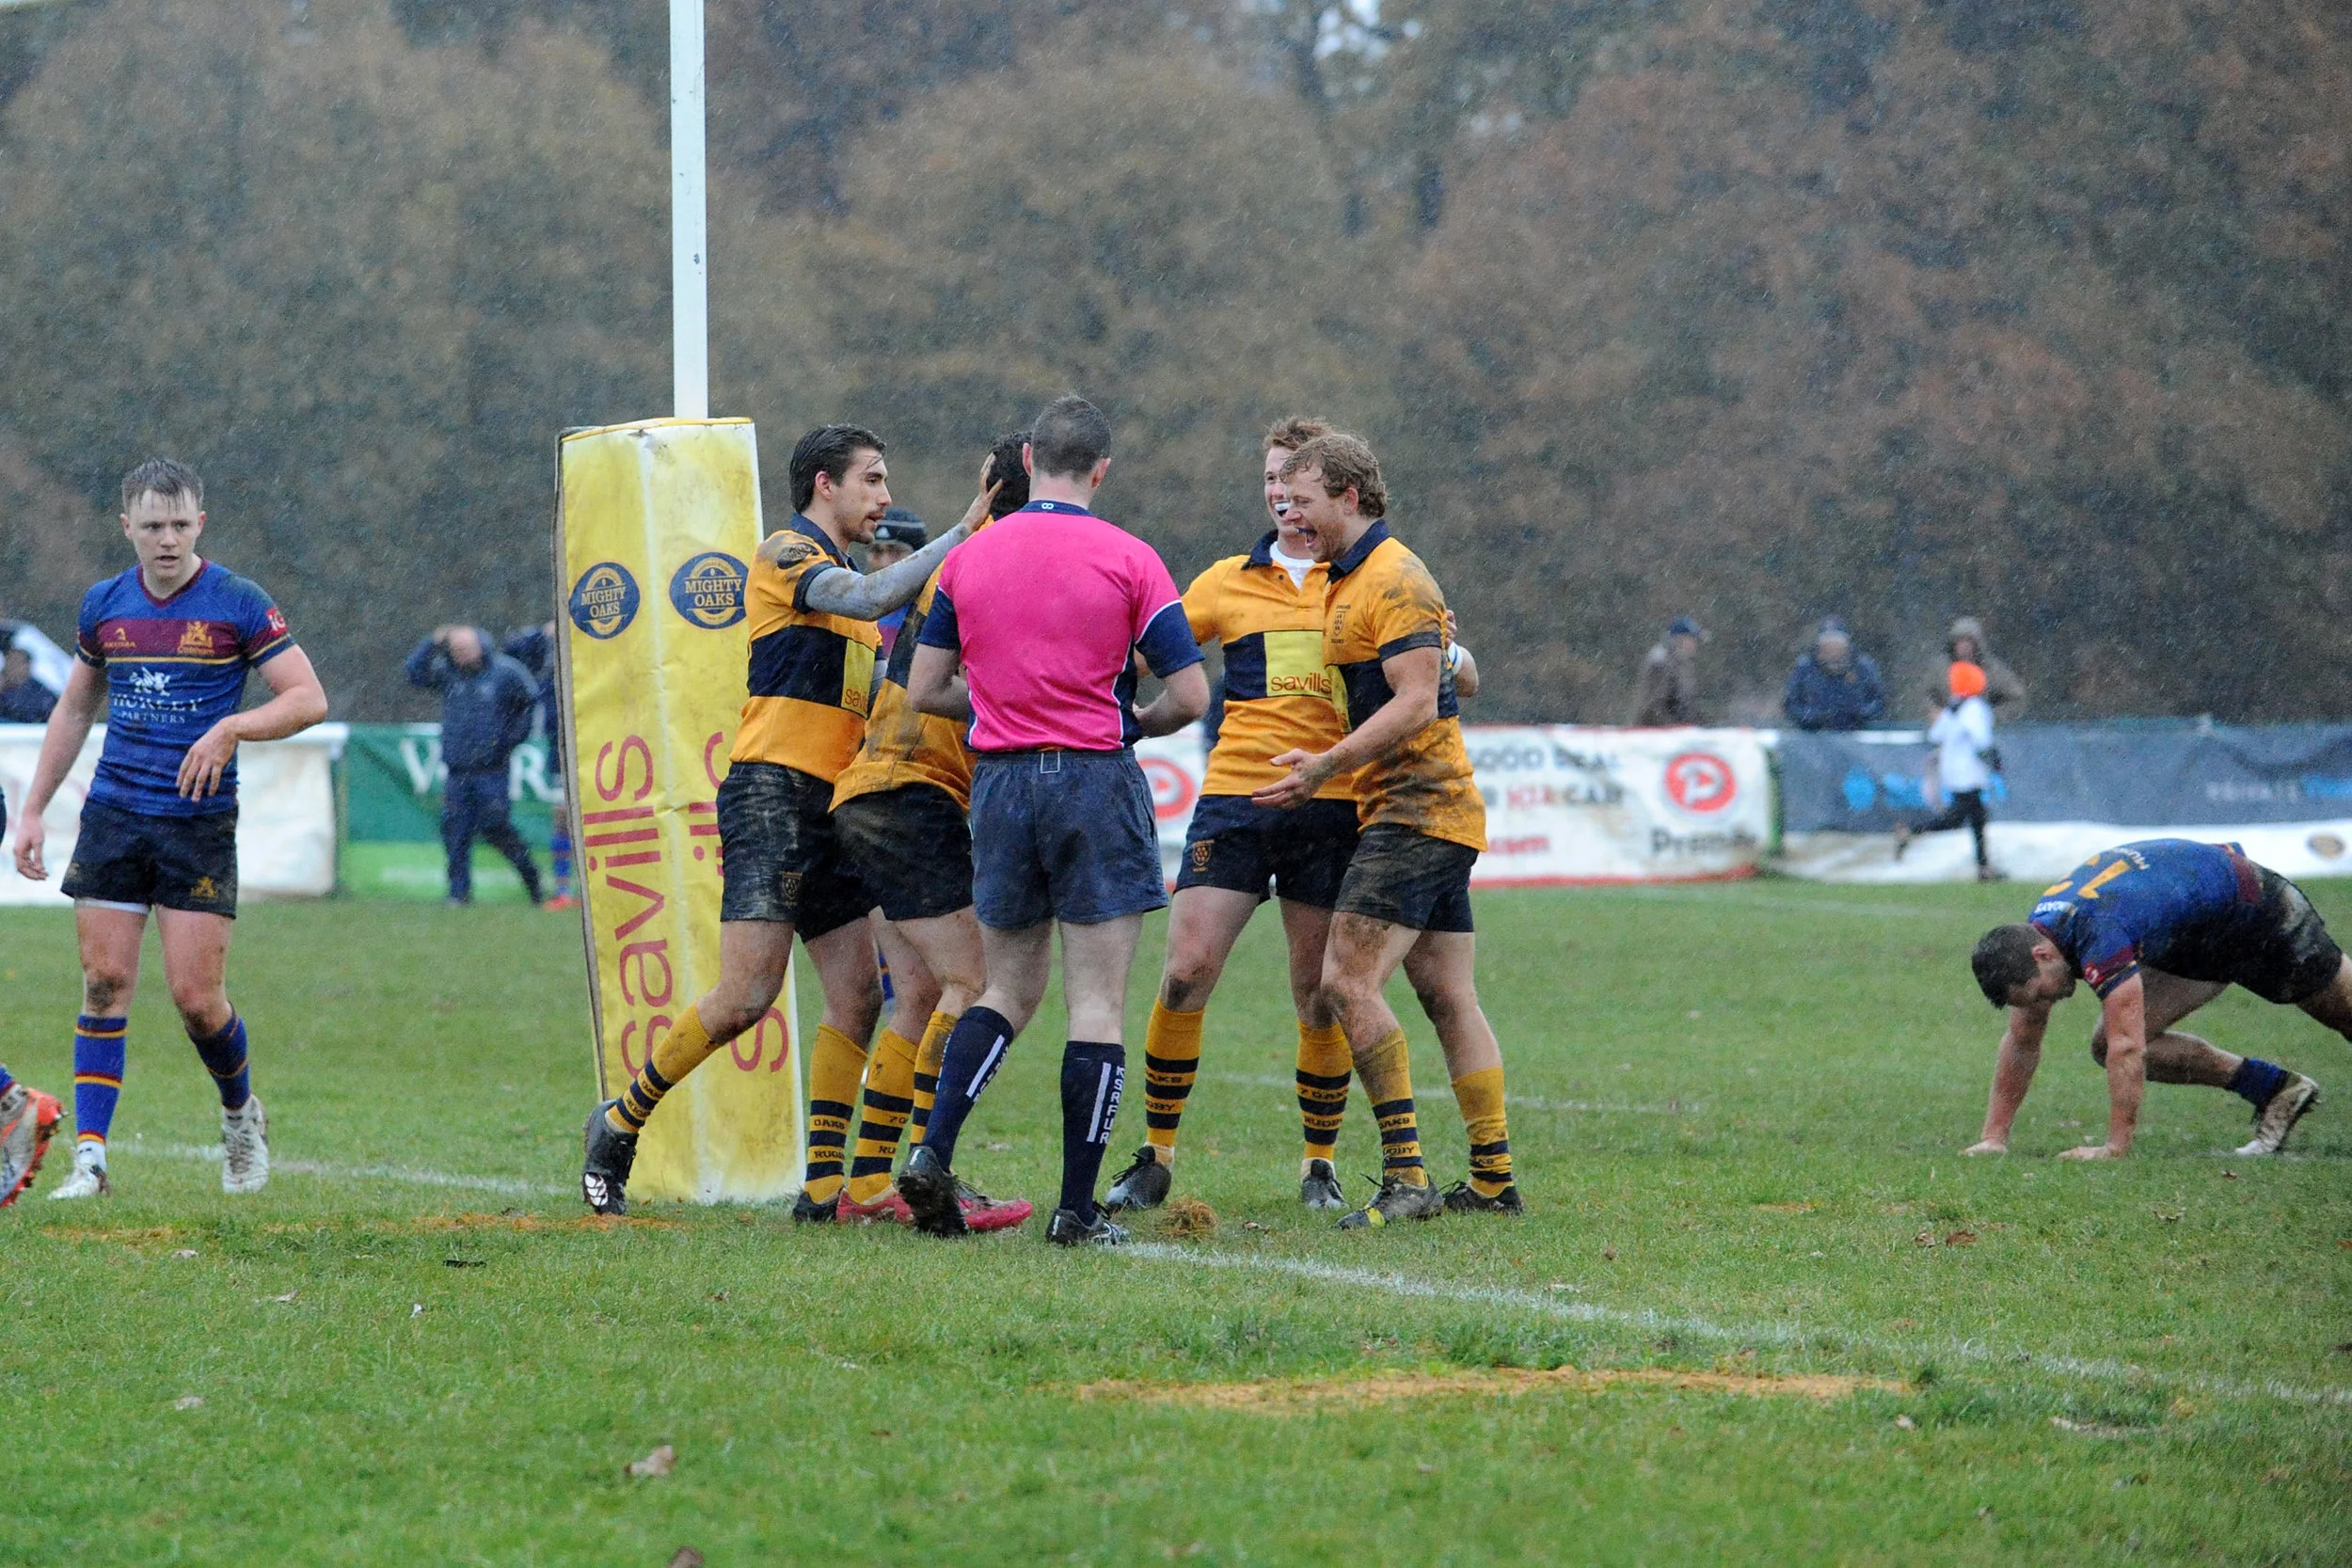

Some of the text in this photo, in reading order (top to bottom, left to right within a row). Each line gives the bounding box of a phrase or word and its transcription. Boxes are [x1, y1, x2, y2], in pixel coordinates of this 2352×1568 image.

[684, 578, 742, 594] MIGHTY
[580, 586, 626, 606] MIGHTY
[694, 594, 735, 607] OAKS
[589, 602, 621, 618] OAKS
[1270, 673, 1332, 695] savills
[111, 693, 203, 712] HURLEY
[121, 710, 186, 724] PARTNERS
[582, 734, 674, 1081] savills
[814, 1118, 846, 1130] OAKS
